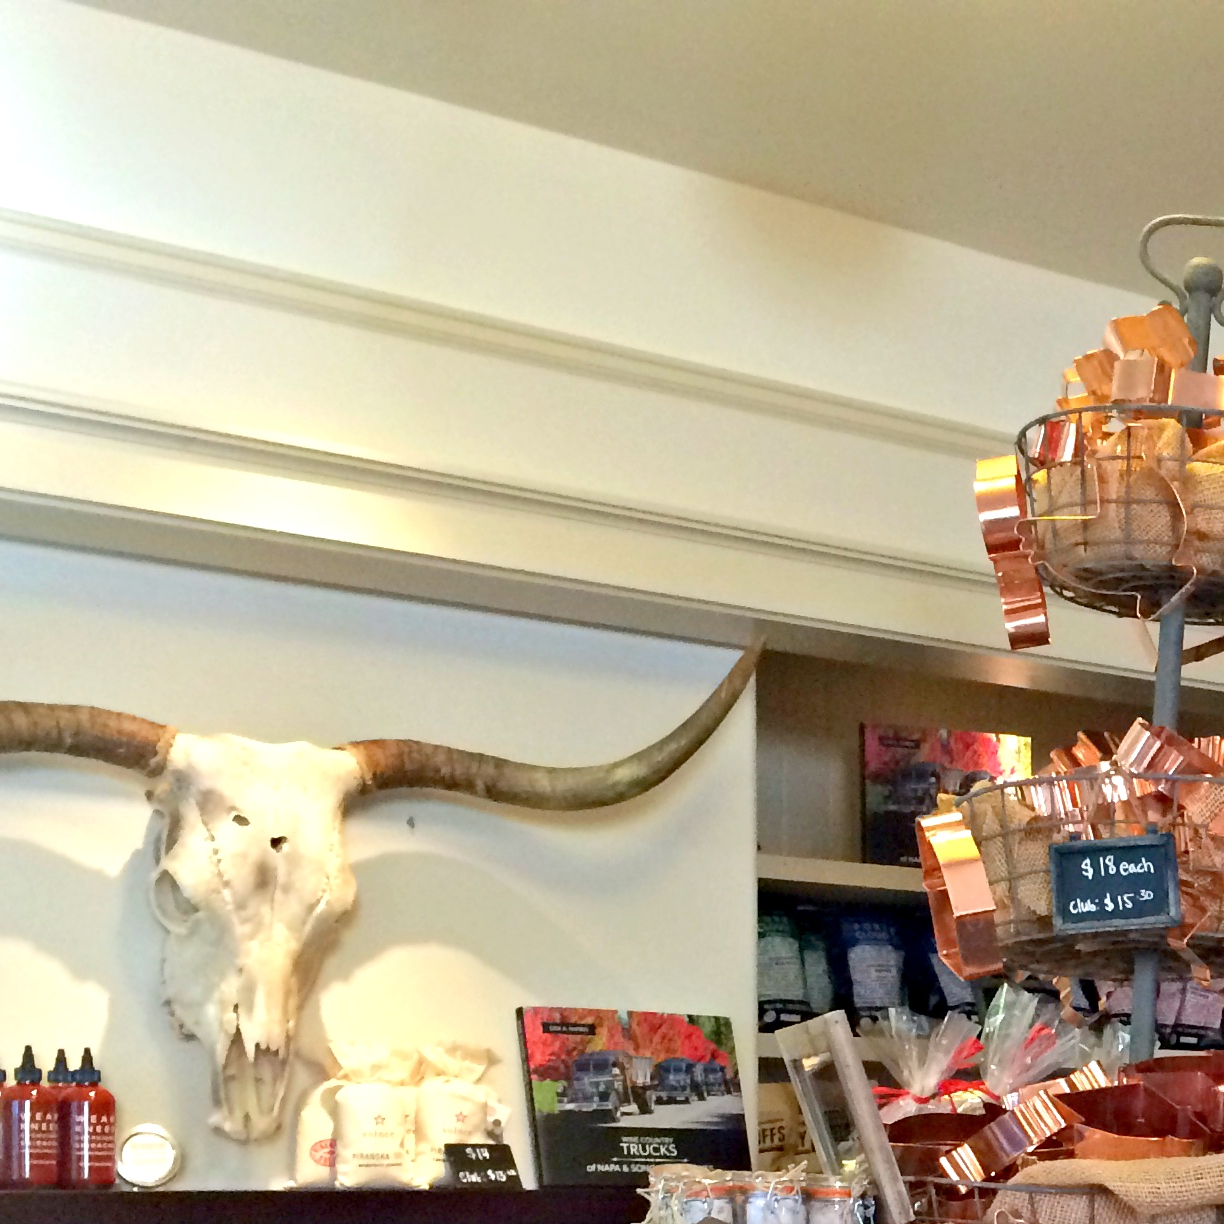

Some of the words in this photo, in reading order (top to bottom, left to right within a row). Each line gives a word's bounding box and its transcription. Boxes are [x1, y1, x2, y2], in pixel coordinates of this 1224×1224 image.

[1120, 857, 1154, 875] each
[619, 1143, 678, 1157] TRUCKS
[597, 1164, 621, 1172] NAPA
